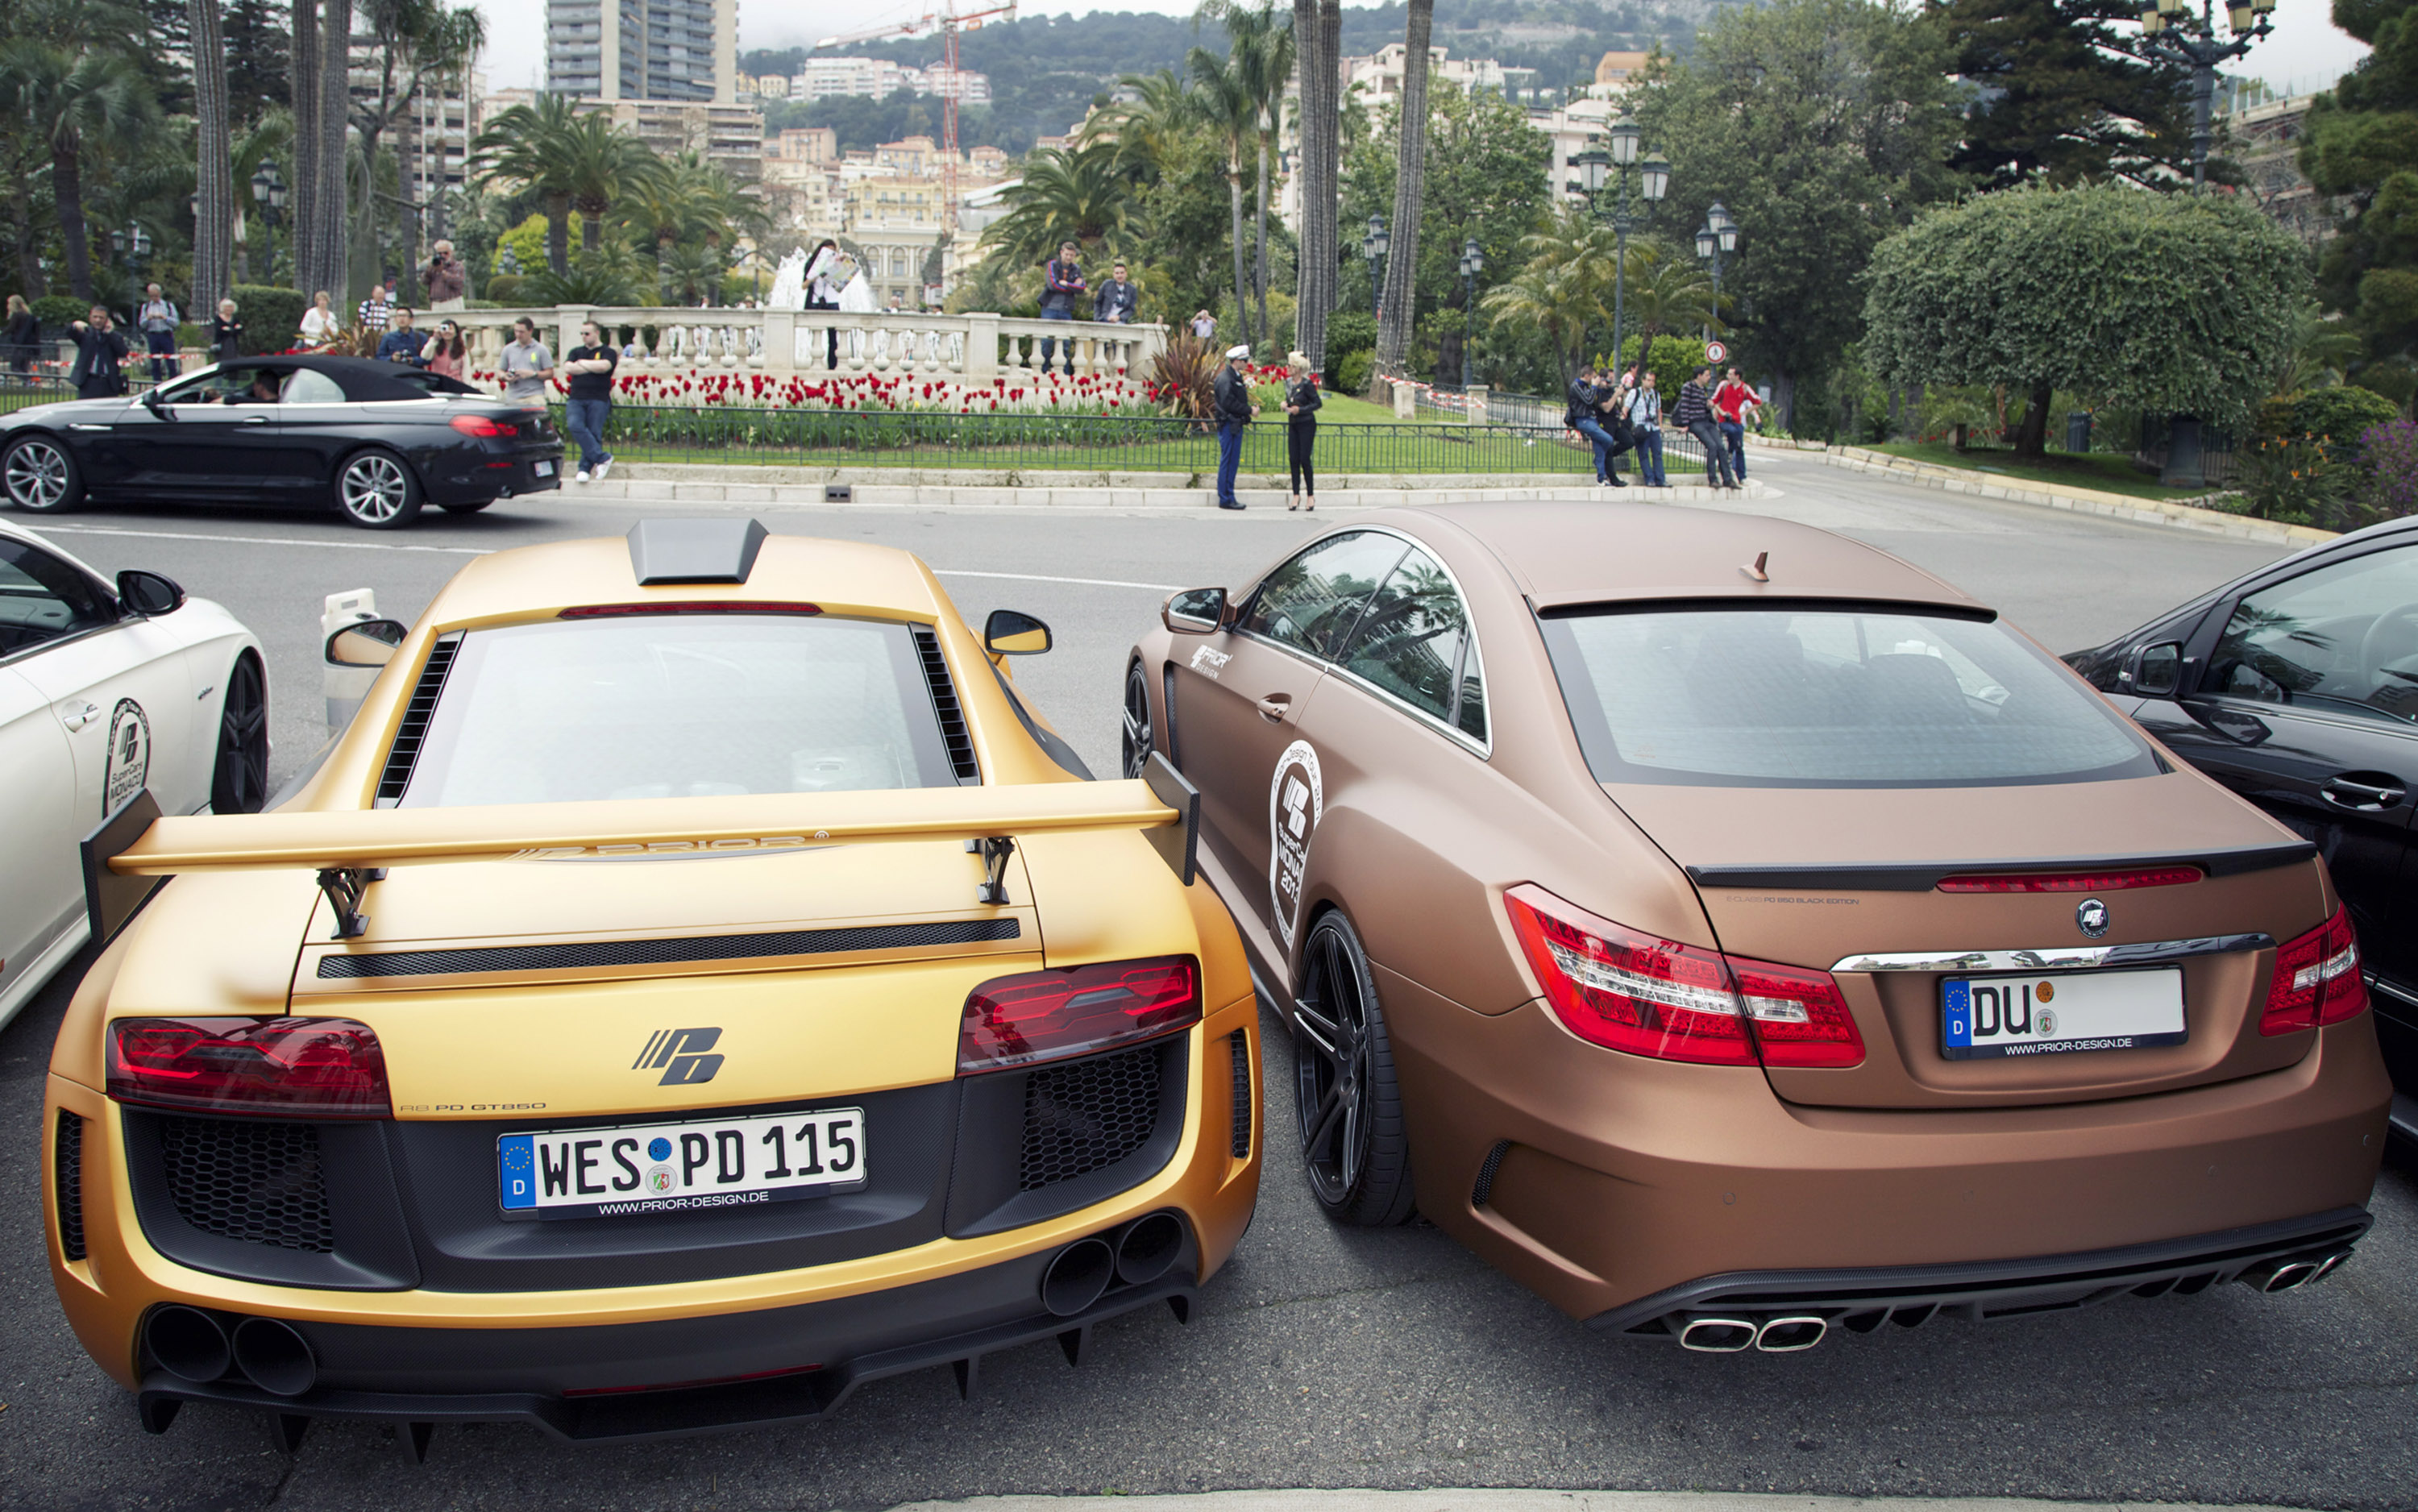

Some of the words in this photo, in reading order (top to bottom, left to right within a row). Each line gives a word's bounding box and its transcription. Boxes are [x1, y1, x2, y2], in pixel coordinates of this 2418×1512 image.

[1196, 663, 1219, 679] DESIGN
[110, 772, 141, 800] MONACO
[1278, 841, 1302, 883] MONA
[1971, 985, 2031, 1036] DU
[1953, 1020, 1963, 1035] D
[2005, 1037, 2133, 1056] WWW.PRIOR-DESIGN.DE
[471, 1103, 546, 1111] GT850
[540, 1138, 641, 1197] WES
[679, 1131, 745, 1186] PD
[762, 1120, 855, 1179] 115
[513, 1180, 526, 1195] D
[598, 1191, 770, 1215] WWW.PRIOR-DESIGN.DE
